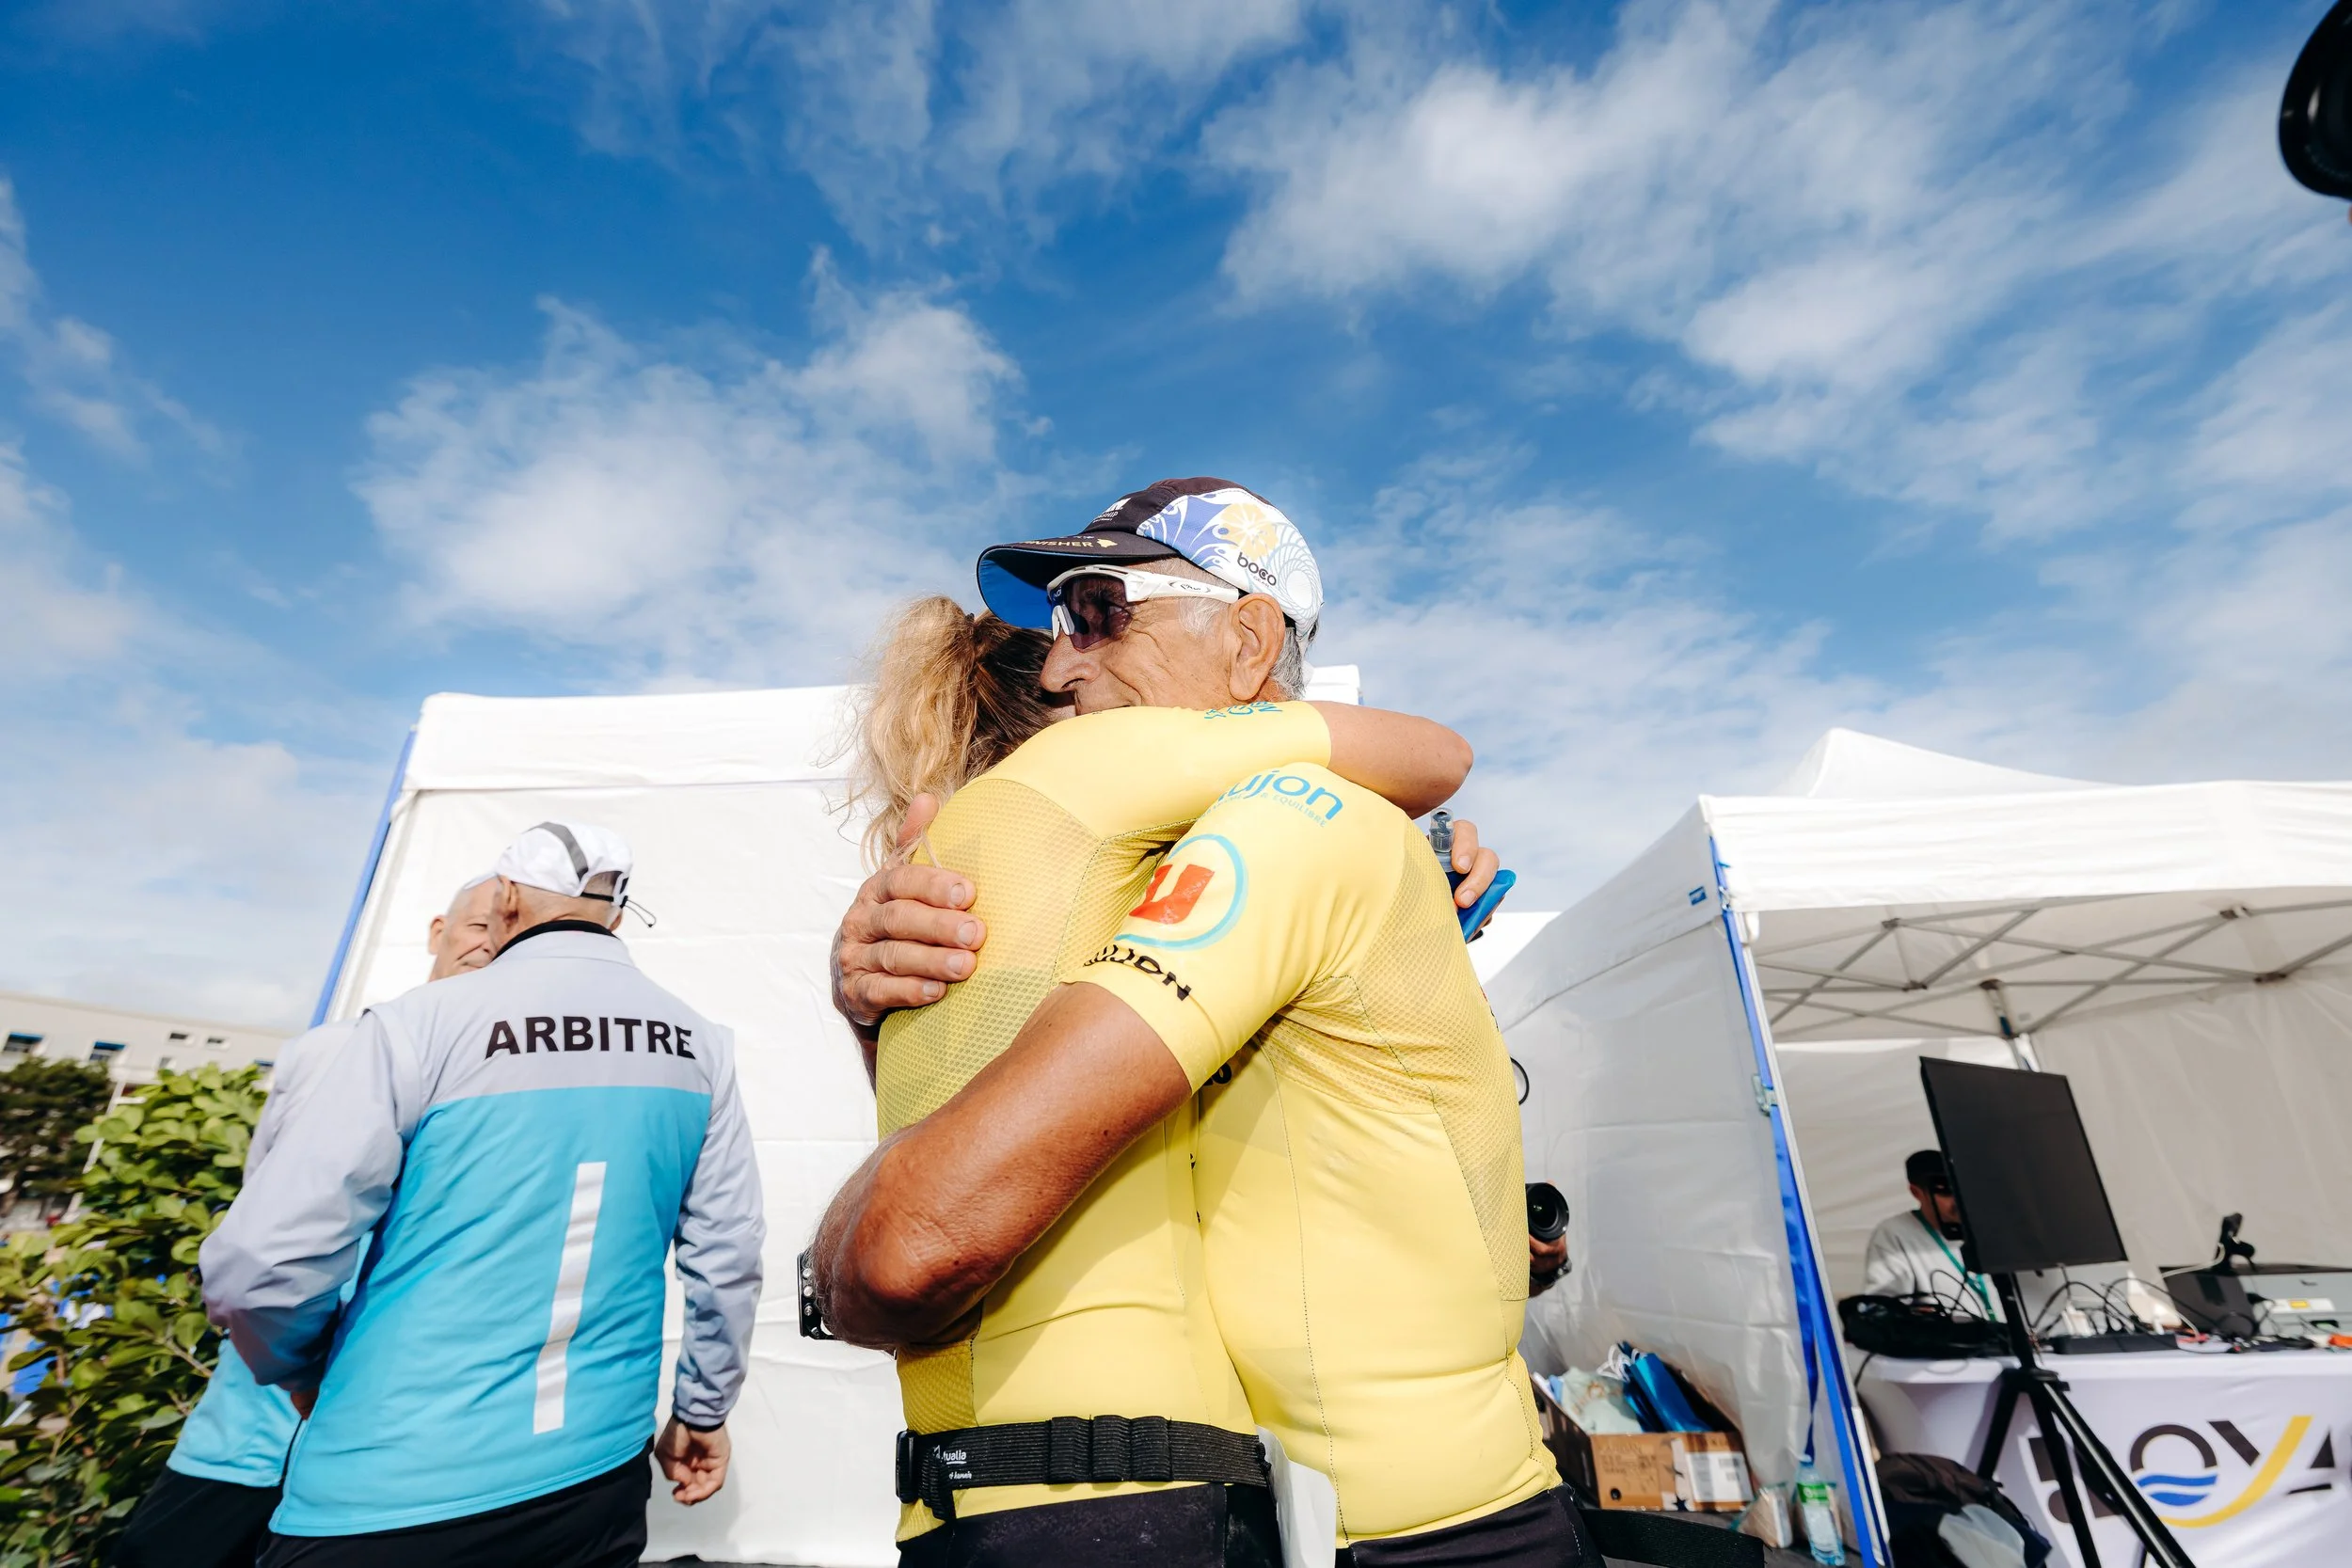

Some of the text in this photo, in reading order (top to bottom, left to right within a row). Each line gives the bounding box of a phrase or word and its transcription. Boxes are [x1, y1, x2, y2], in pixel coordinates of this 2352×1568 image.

[1237, 552, 1277, 586] boco
[1217, 769, 1343, 821] ujon
[484, 1015, 696, 1060] ARBITRE
[943, 1449, 967, 1462] tualia
